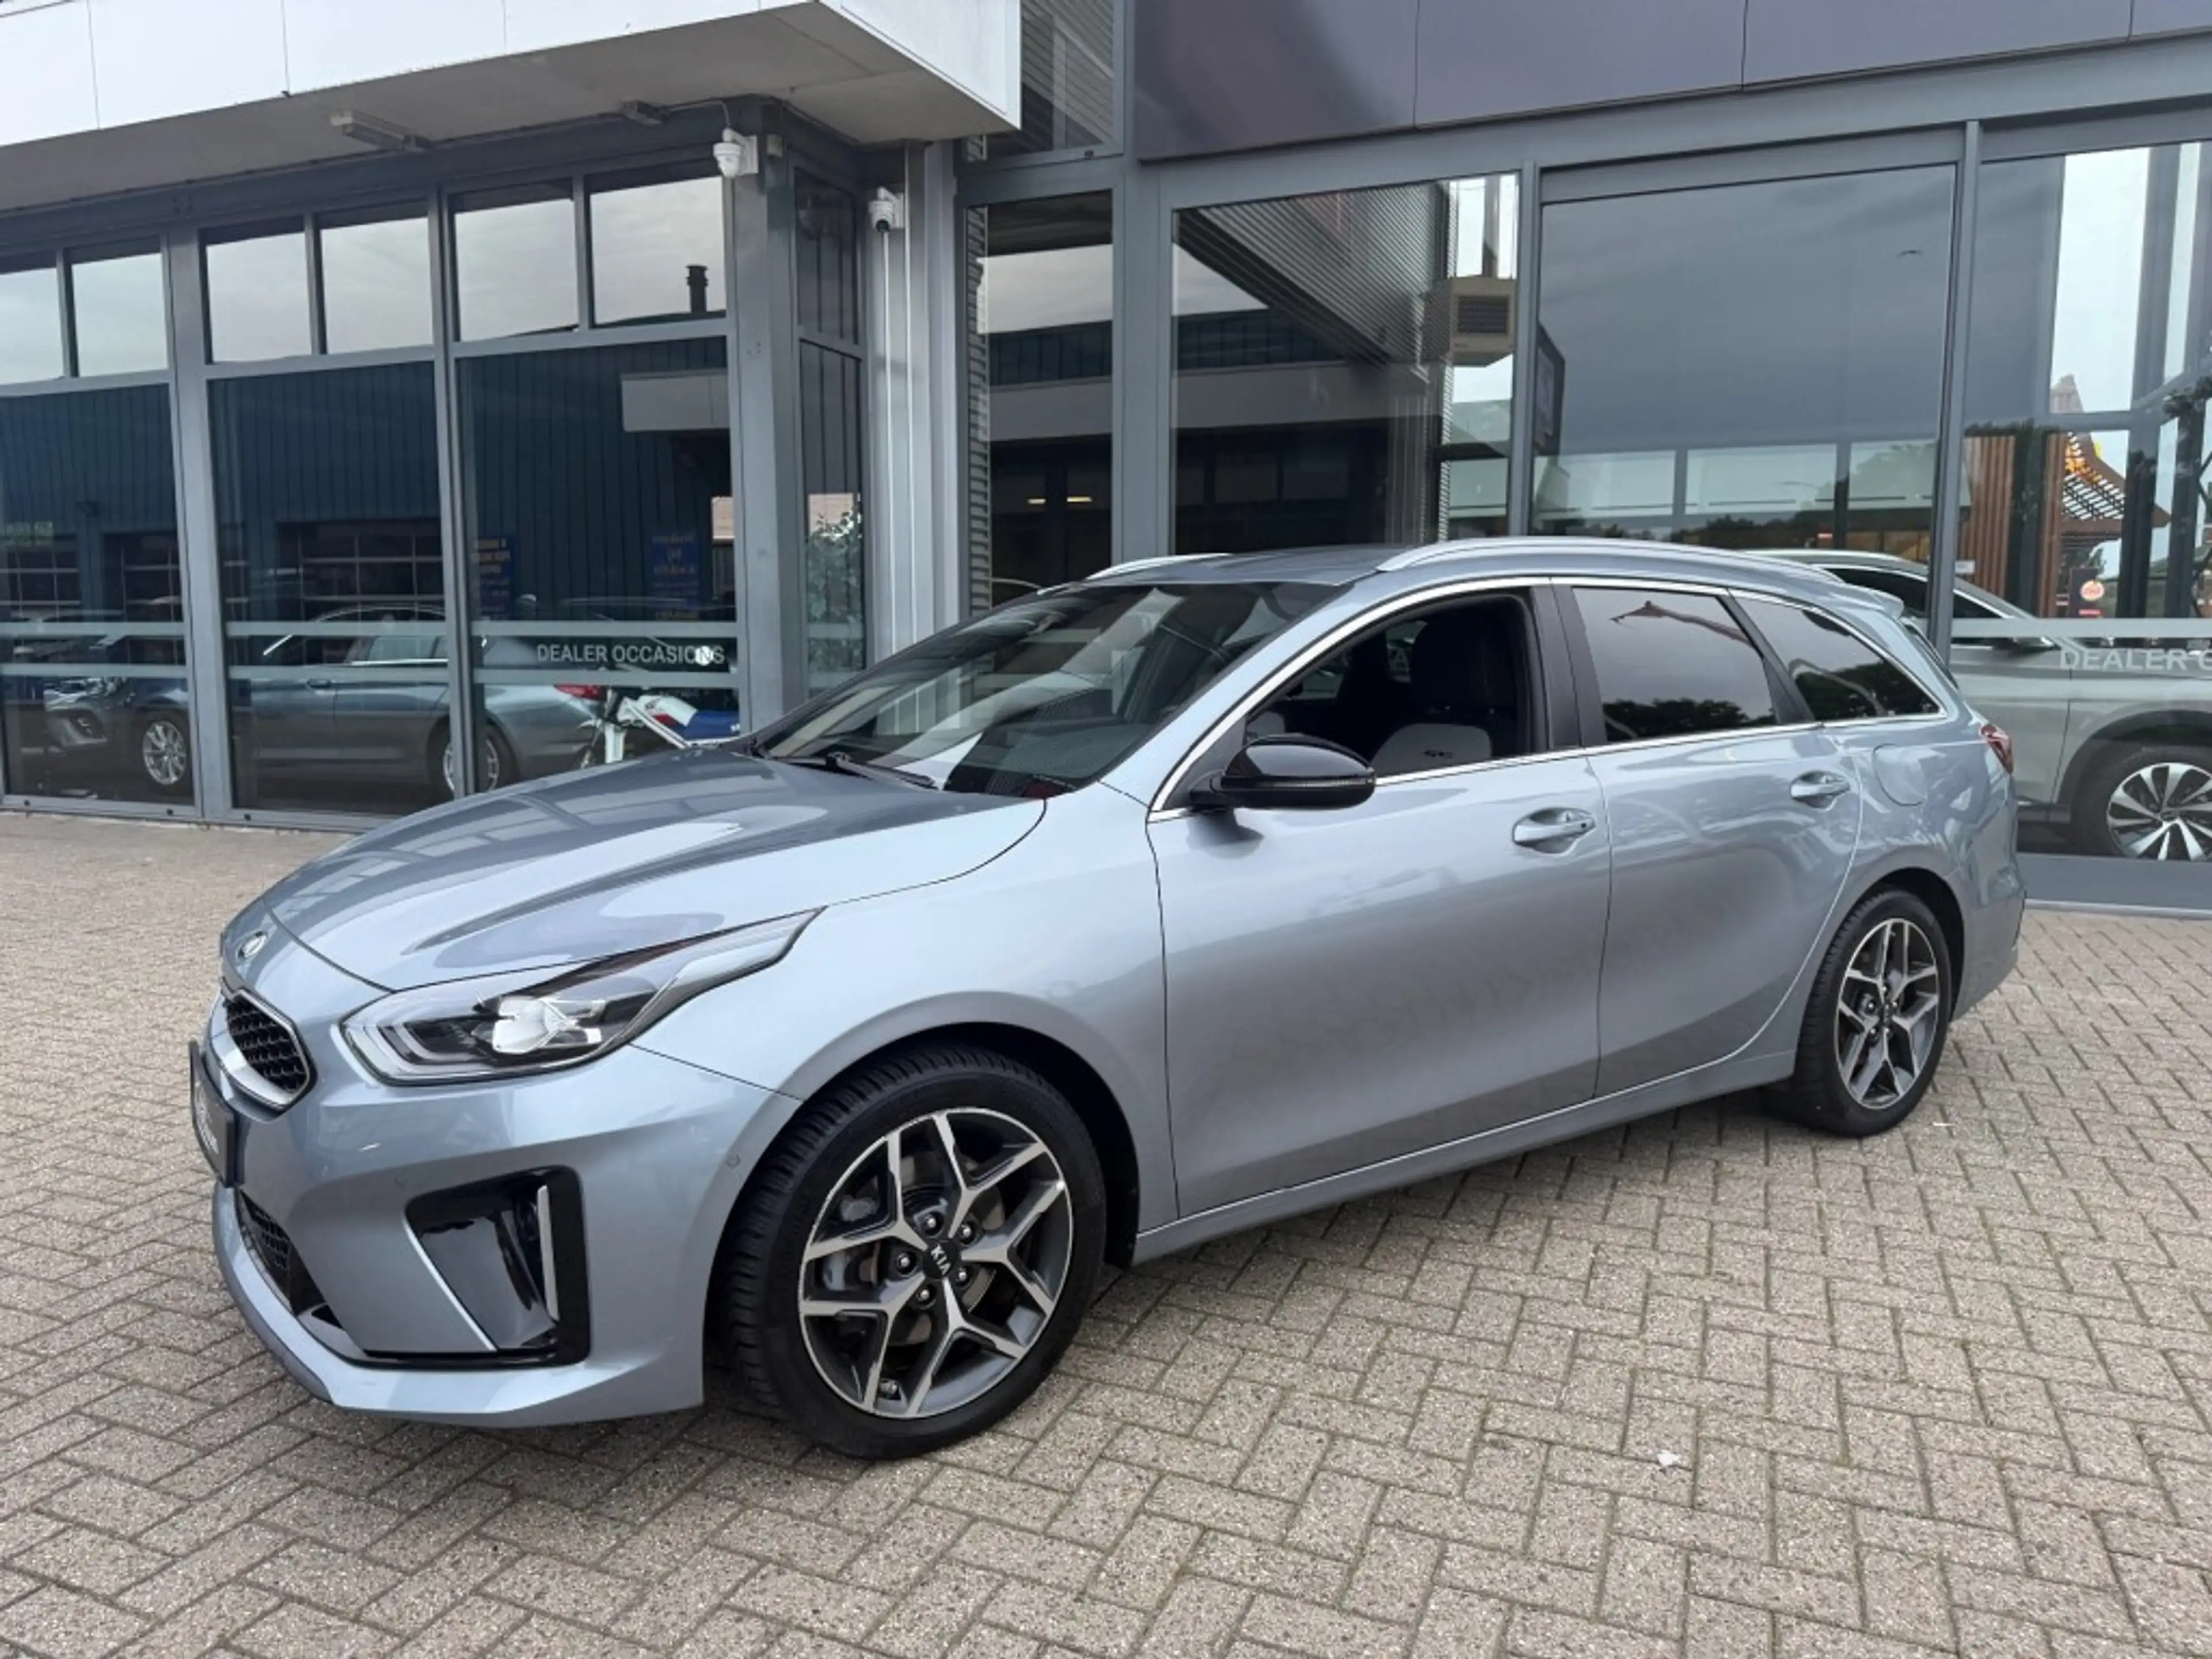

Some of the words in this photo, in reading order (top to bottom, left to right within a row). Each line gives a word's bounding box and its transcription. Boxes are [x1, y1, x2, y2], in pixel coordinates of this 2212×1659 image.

[537, 643, 607, 662] DEALER
[611, 645, 725, 665] OCCASIONS
[2061, 647, 2187, 671] DEALER
[930, 1244, 952, 1275] KIA
